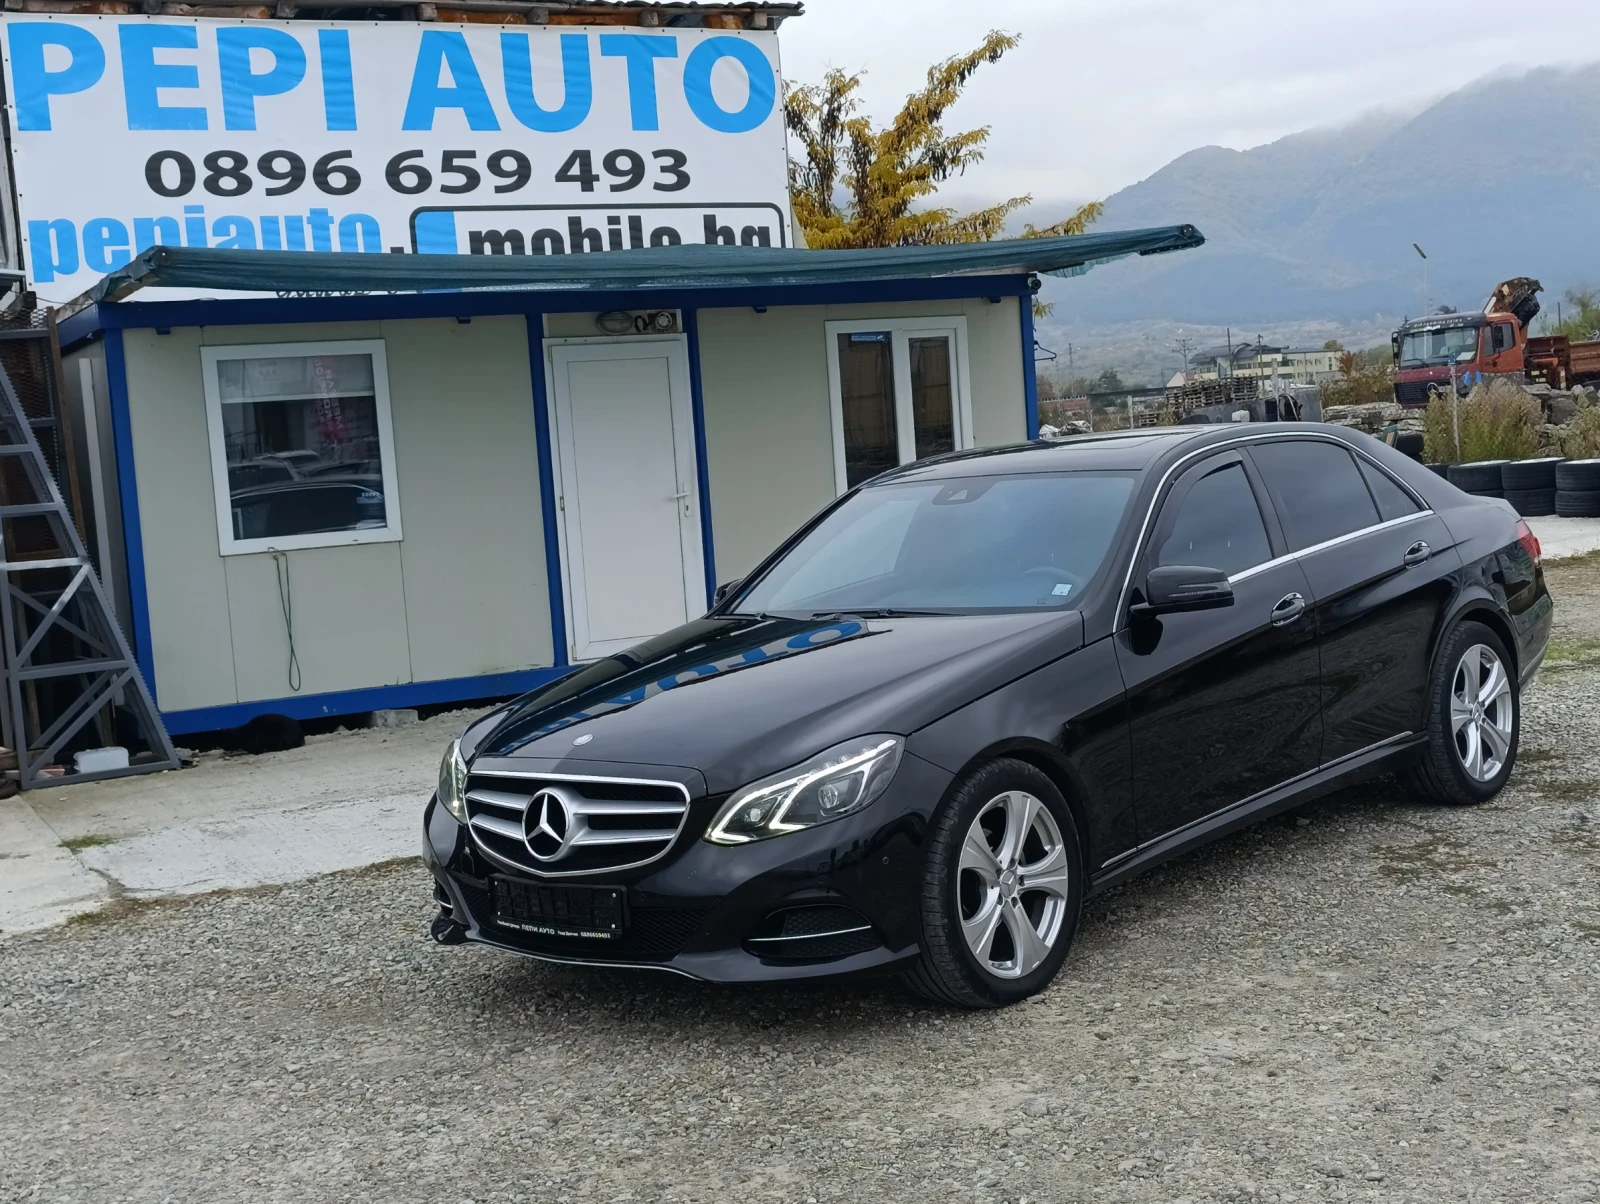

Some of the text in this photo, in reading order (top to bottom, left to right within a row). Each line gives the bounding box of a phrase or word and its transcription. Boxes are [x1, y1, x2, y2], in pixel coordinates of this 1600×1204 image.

[7, 22, 775, 133] PEPI AUTO
[145, 148, 691, 197] 0896 659 493
